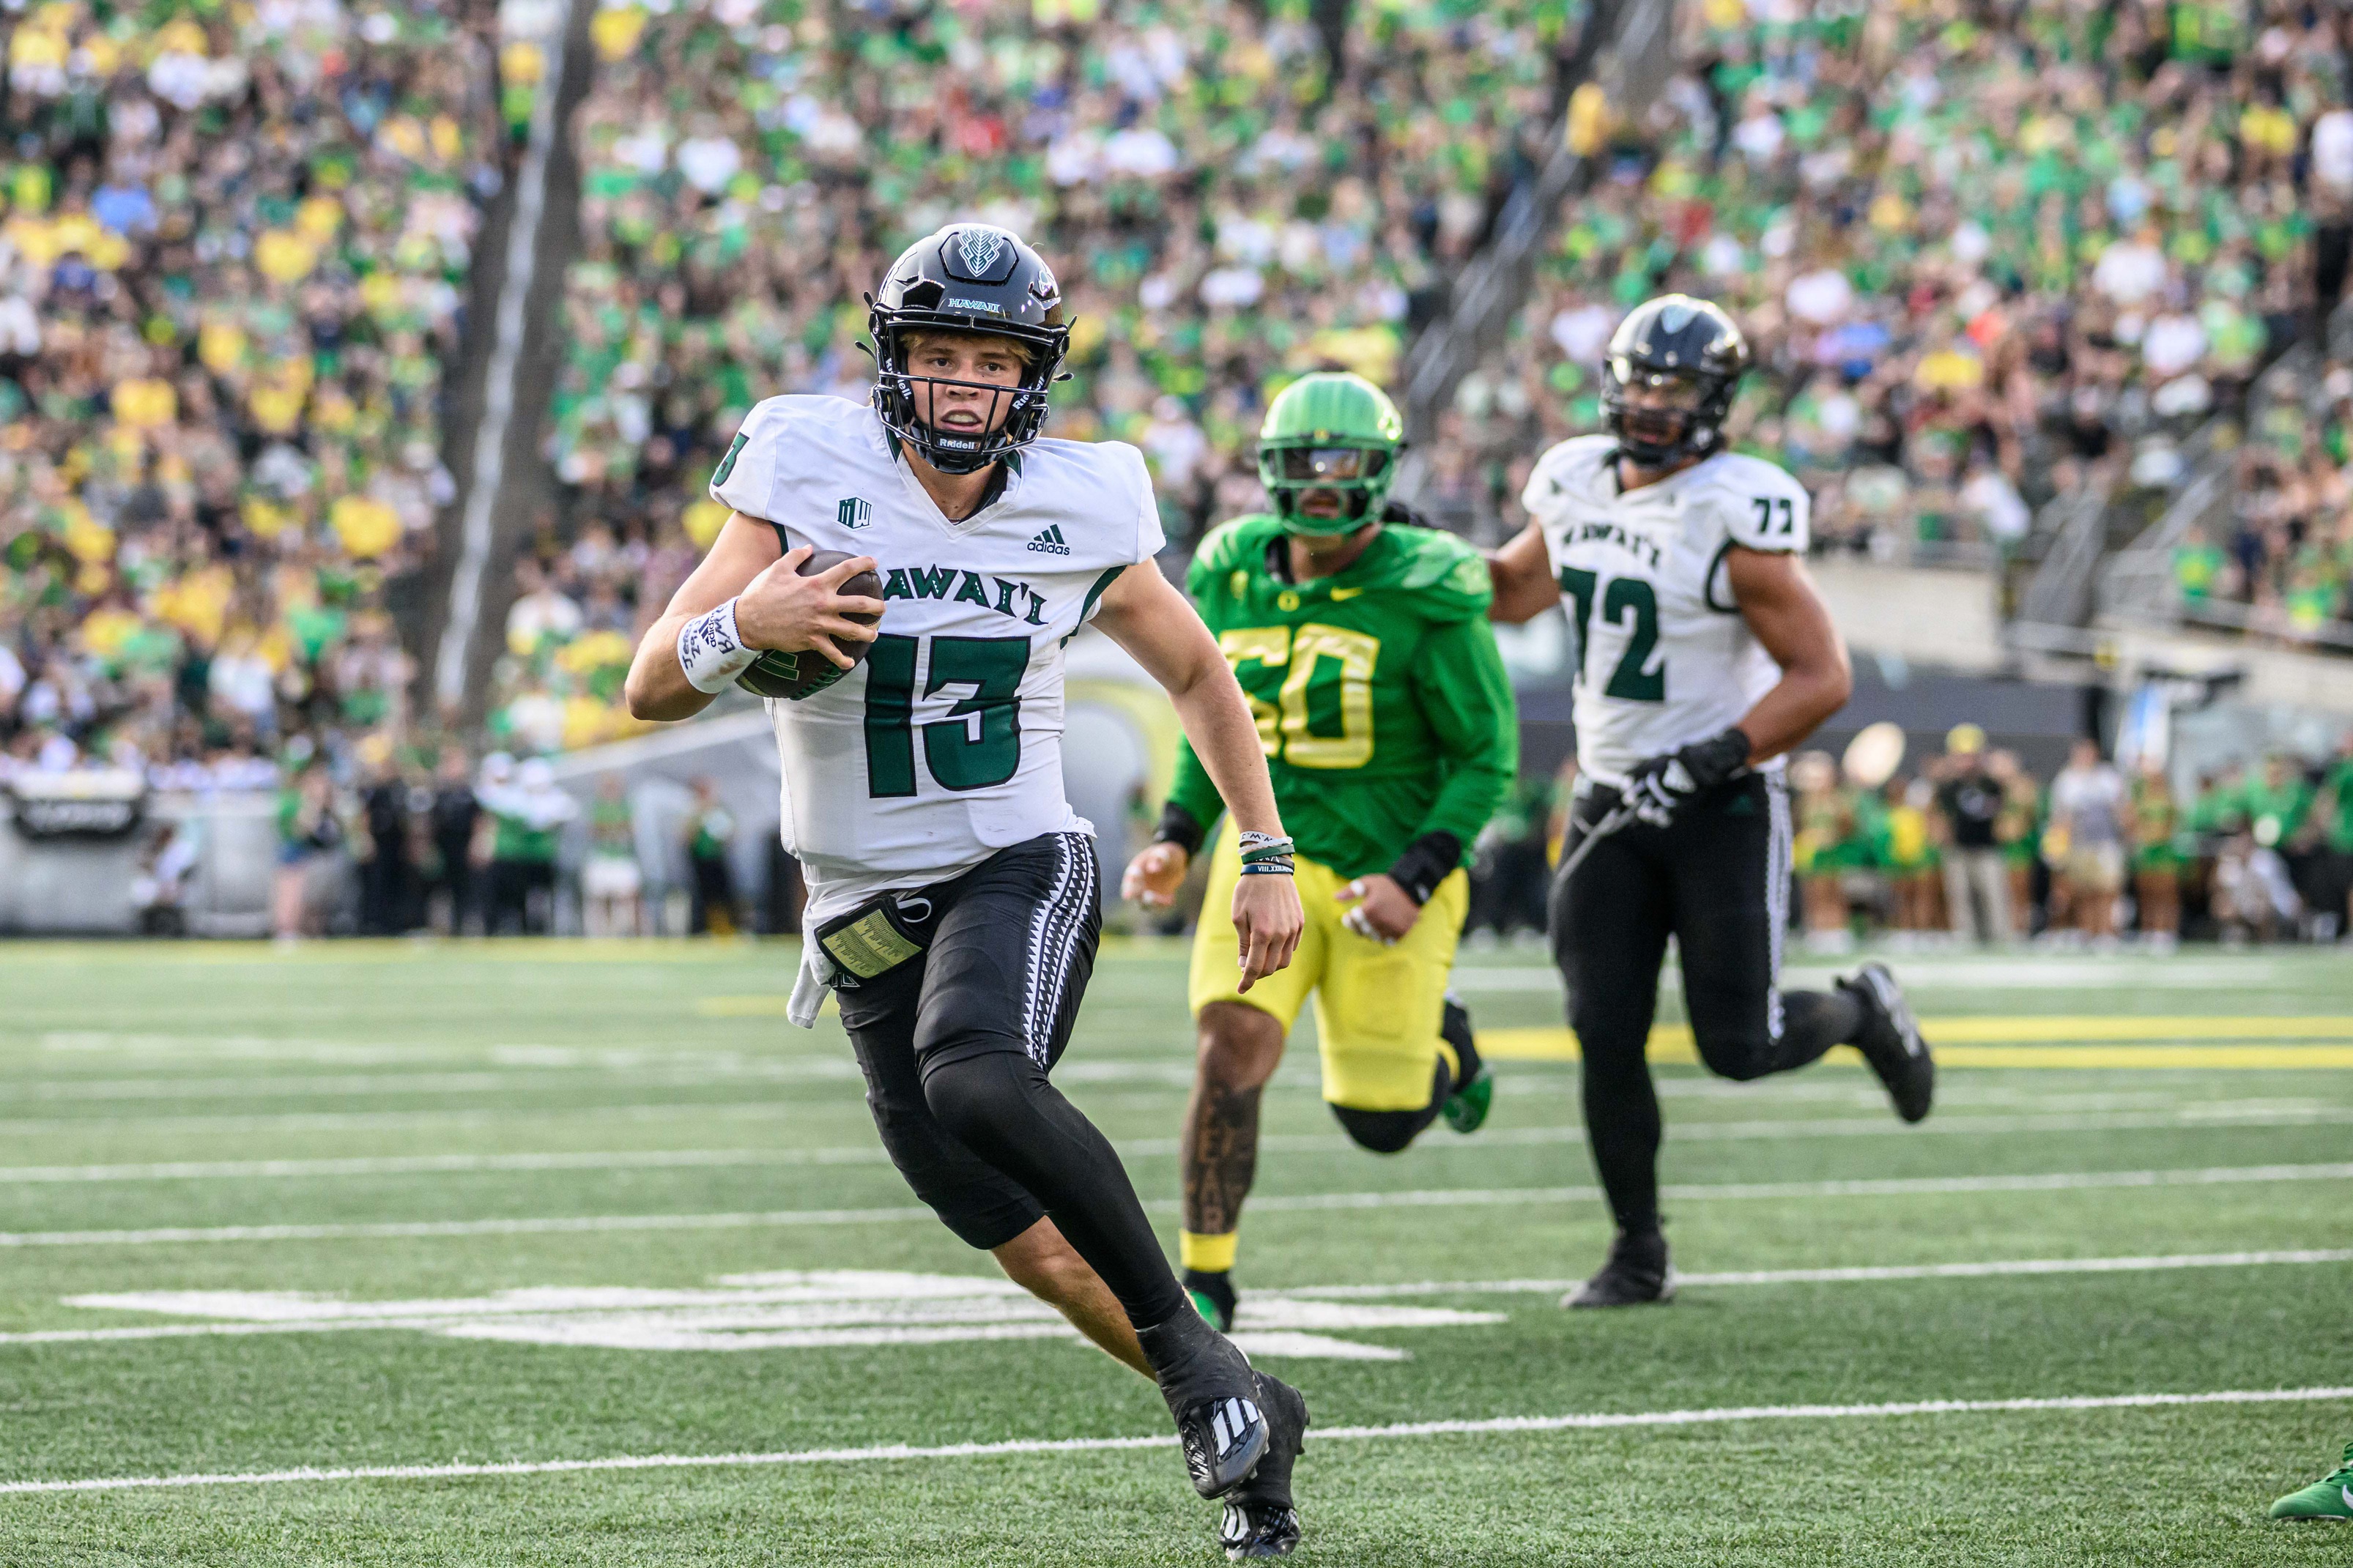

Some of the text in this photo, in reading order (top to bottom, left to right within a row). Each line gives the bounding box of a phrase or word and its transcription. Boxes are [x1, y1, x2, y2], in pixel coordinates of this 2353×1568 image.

[948, 298, 1001, 313] HAWAII
[940, 438, 975, 450] Riddell
[1027, 540, 1070, 556] adidas
[883, 564, 1049, 625] AWAI'I
[1560, 565, 1664, 702] 72
[864, 633, 1031, 798] 13
